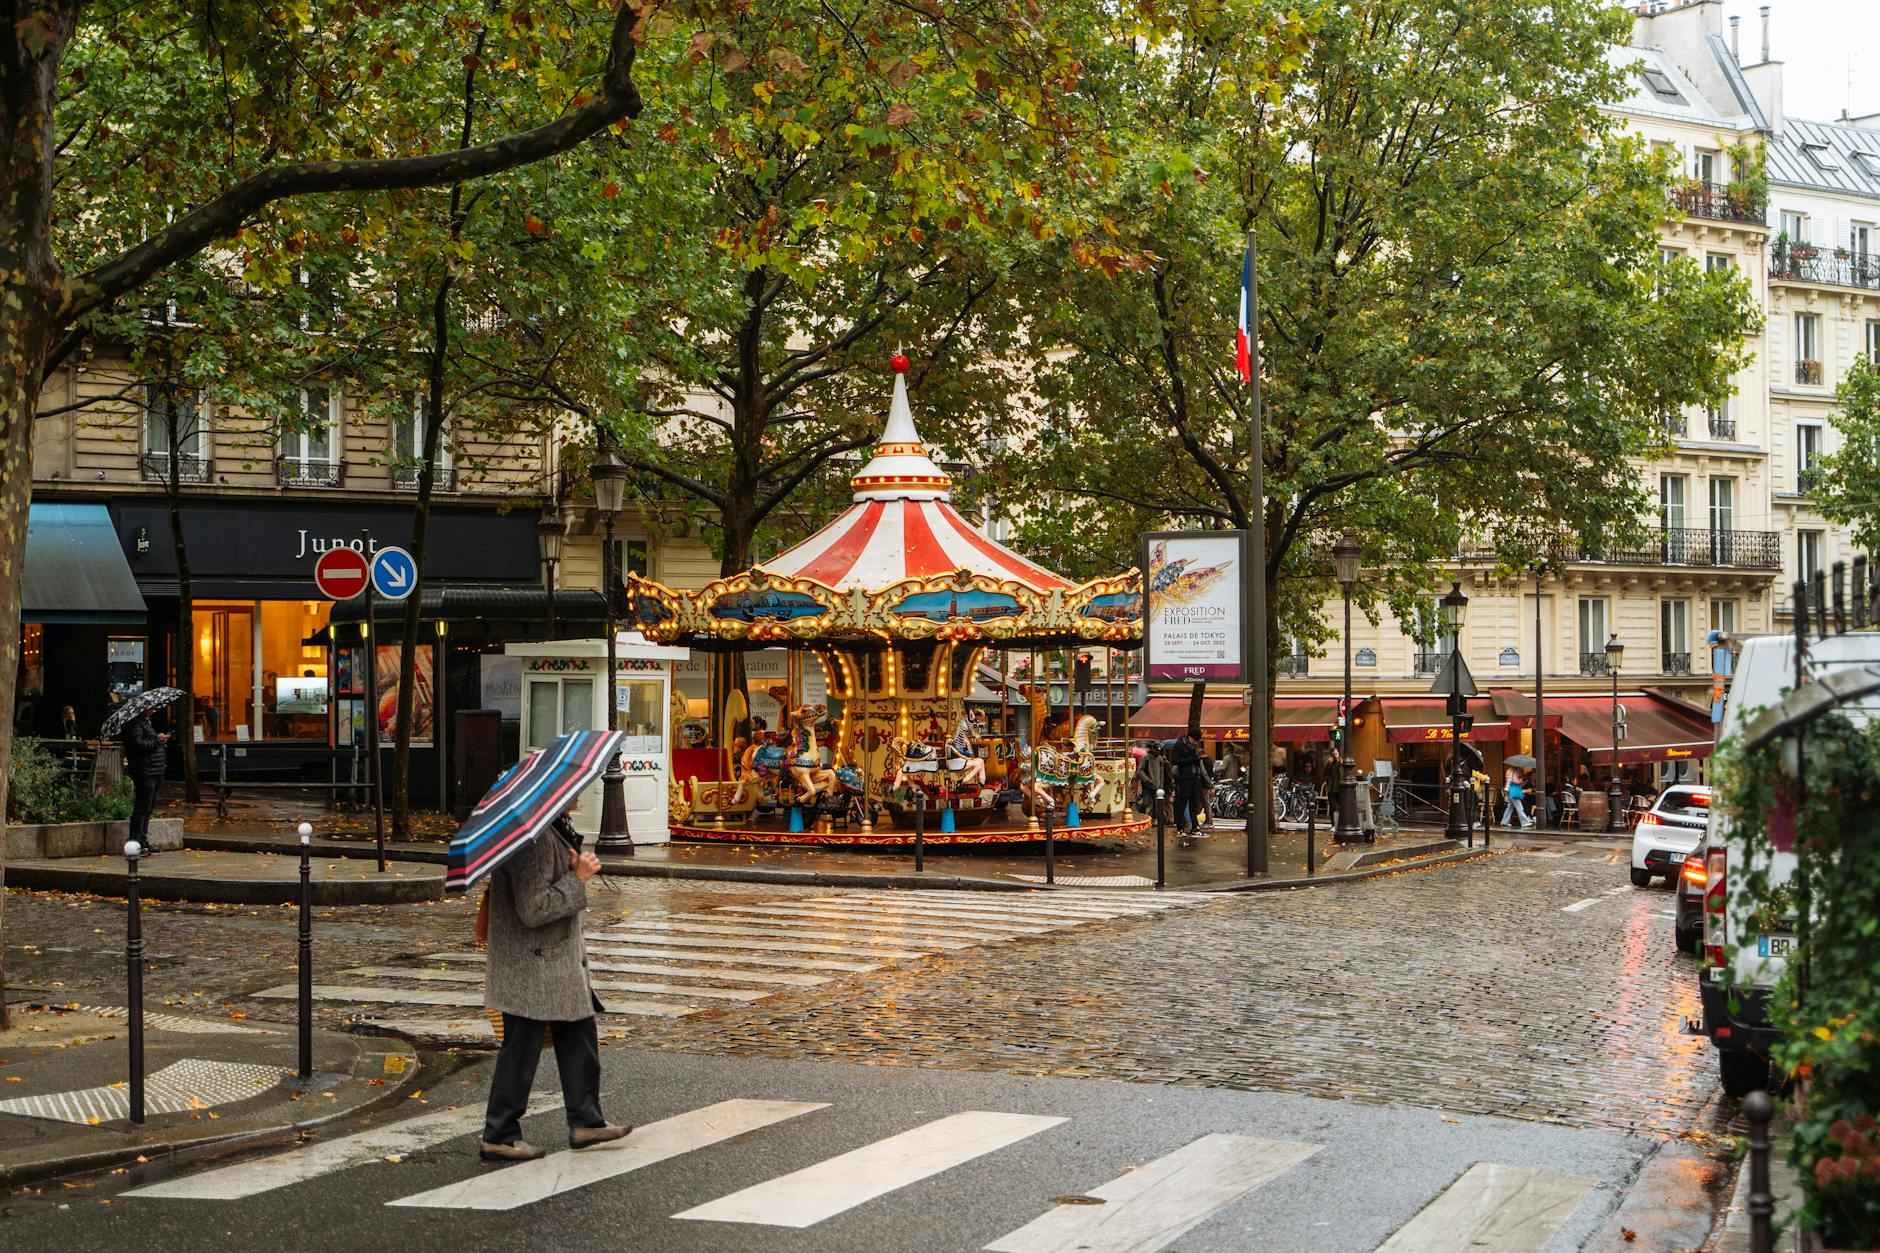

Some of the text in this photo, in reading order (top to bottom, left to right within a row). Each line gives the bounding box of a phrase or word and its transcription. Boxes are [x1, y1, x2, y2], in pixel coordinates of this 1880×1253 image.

[295, 529, 378, 558] Junot
[1164, 606, 1226, 617] EXPOSITION
[1164, 616, 1191, 625] FRED
[1163, 632, 1226, 640] PALAIS DE TOKYO
[1184, 666, 1206, 675] FRED
